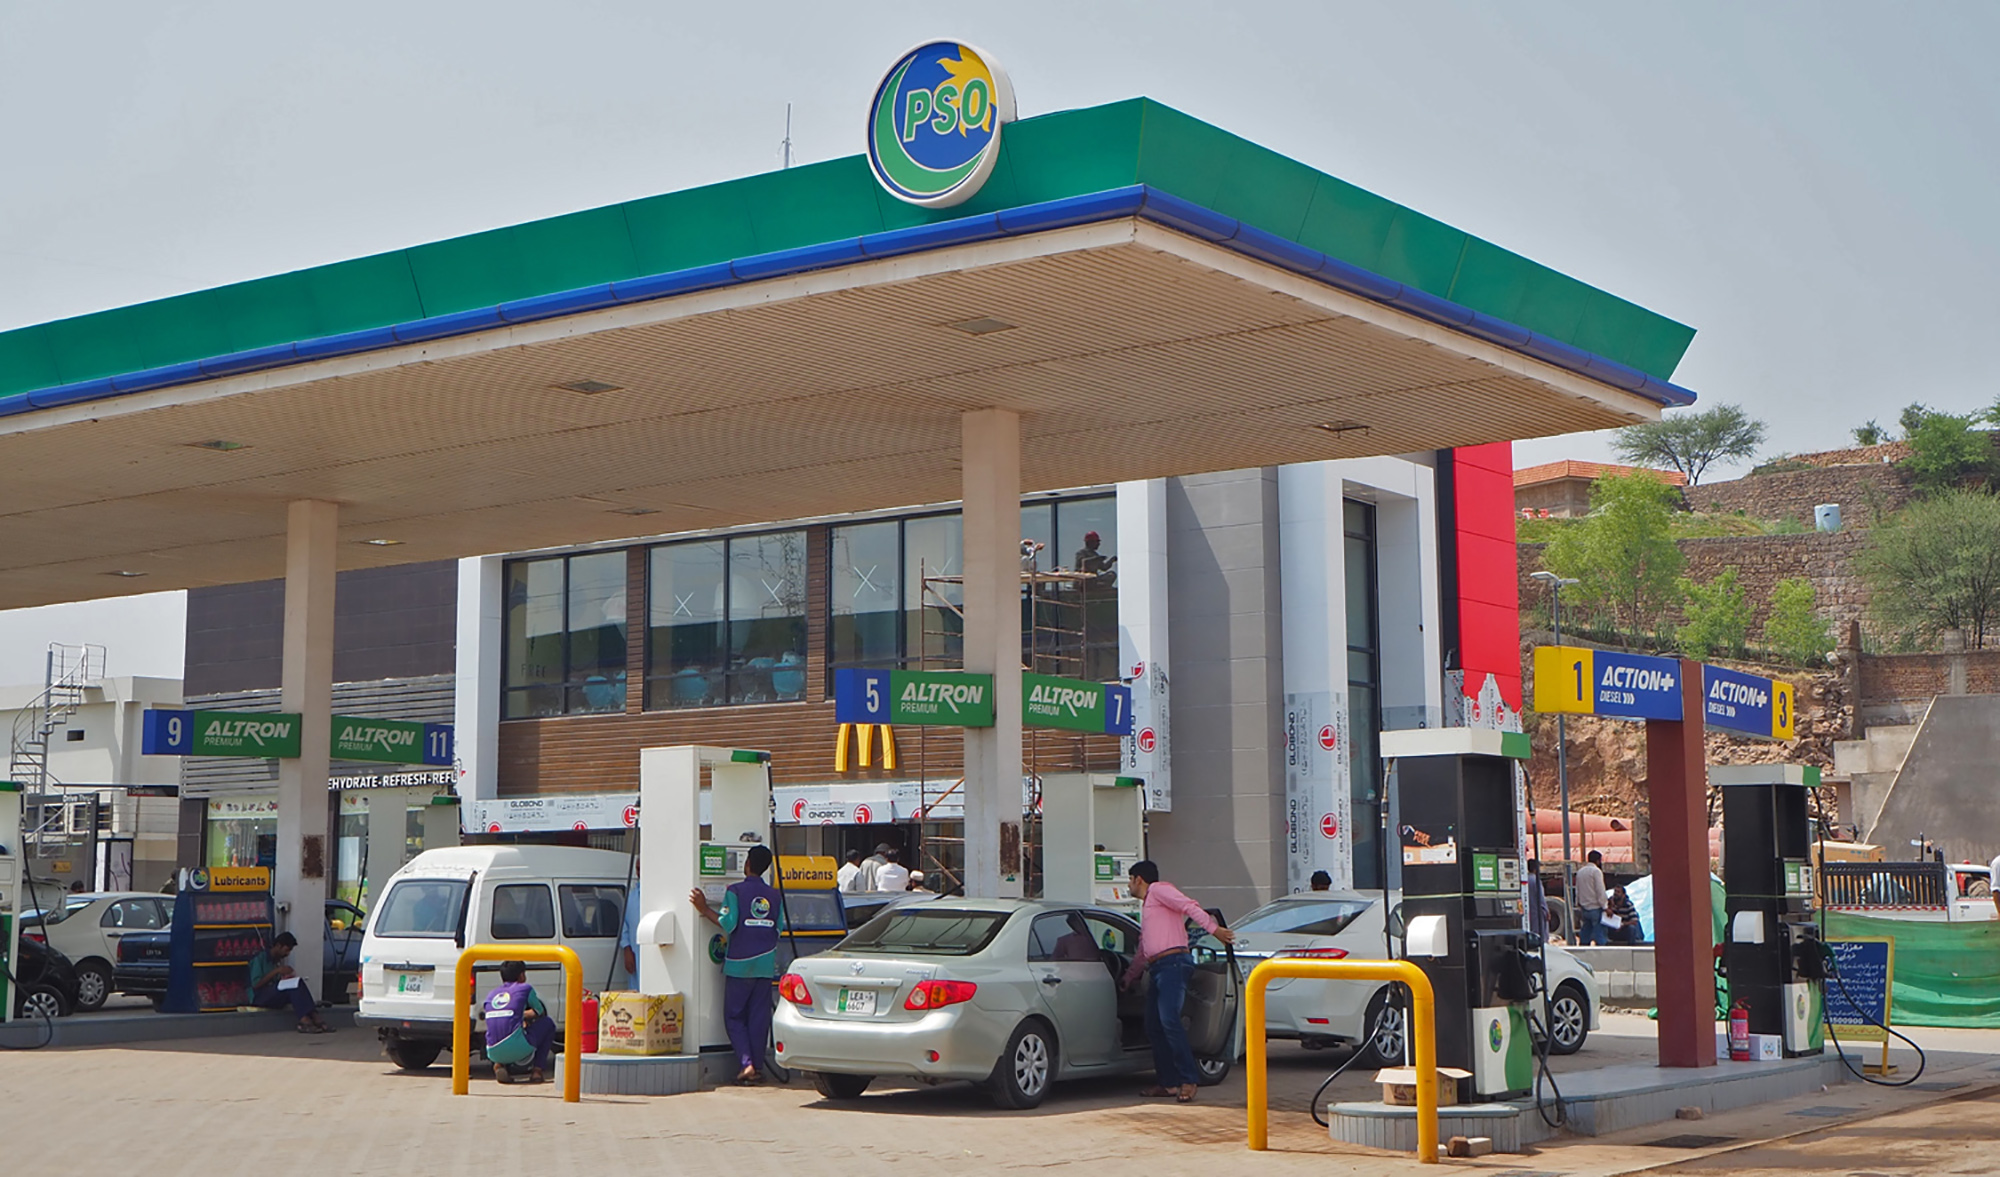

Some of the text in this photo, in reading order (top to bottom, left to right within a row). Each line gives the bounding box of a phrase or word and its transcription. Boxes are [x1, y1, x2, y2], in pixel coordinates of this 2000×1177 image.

[903, 77, 989, 143] PSO
[1573, 660, 1583, 701] 1
[866, 678, 880, 713] 5
[900, 702, 938, 713] PREMIUM
[901, 682, 984, 714] ALTRON
[1029, 684, 1098, 717] ALTRON
[1600, 690, 1622, 704] DIESEL
[1708, 701, 1726, 716] DIESEL
[1028, 703, 1060, 716] PREMIUM
[1114, 694, 1123, 725] 7
[1779, 690, 1788, 728] 3
[167, 717, 182, 746] 9
[203, 737, 242, 746] PREMIUM
[204, 720, 291, 746] ALTRON
[339, 726, 416, 752] ALTRON
[430, 731, 447, 757] 11
[1288, 711, 1297, 766] GLOBOND
[338, 741, 373, 751] PREMIUM
[510, 800, 544, 808] GLOBOND
[1290, 798, 1298, 854] GLOBOND
[214, 875, 266, 886] Lubricants
